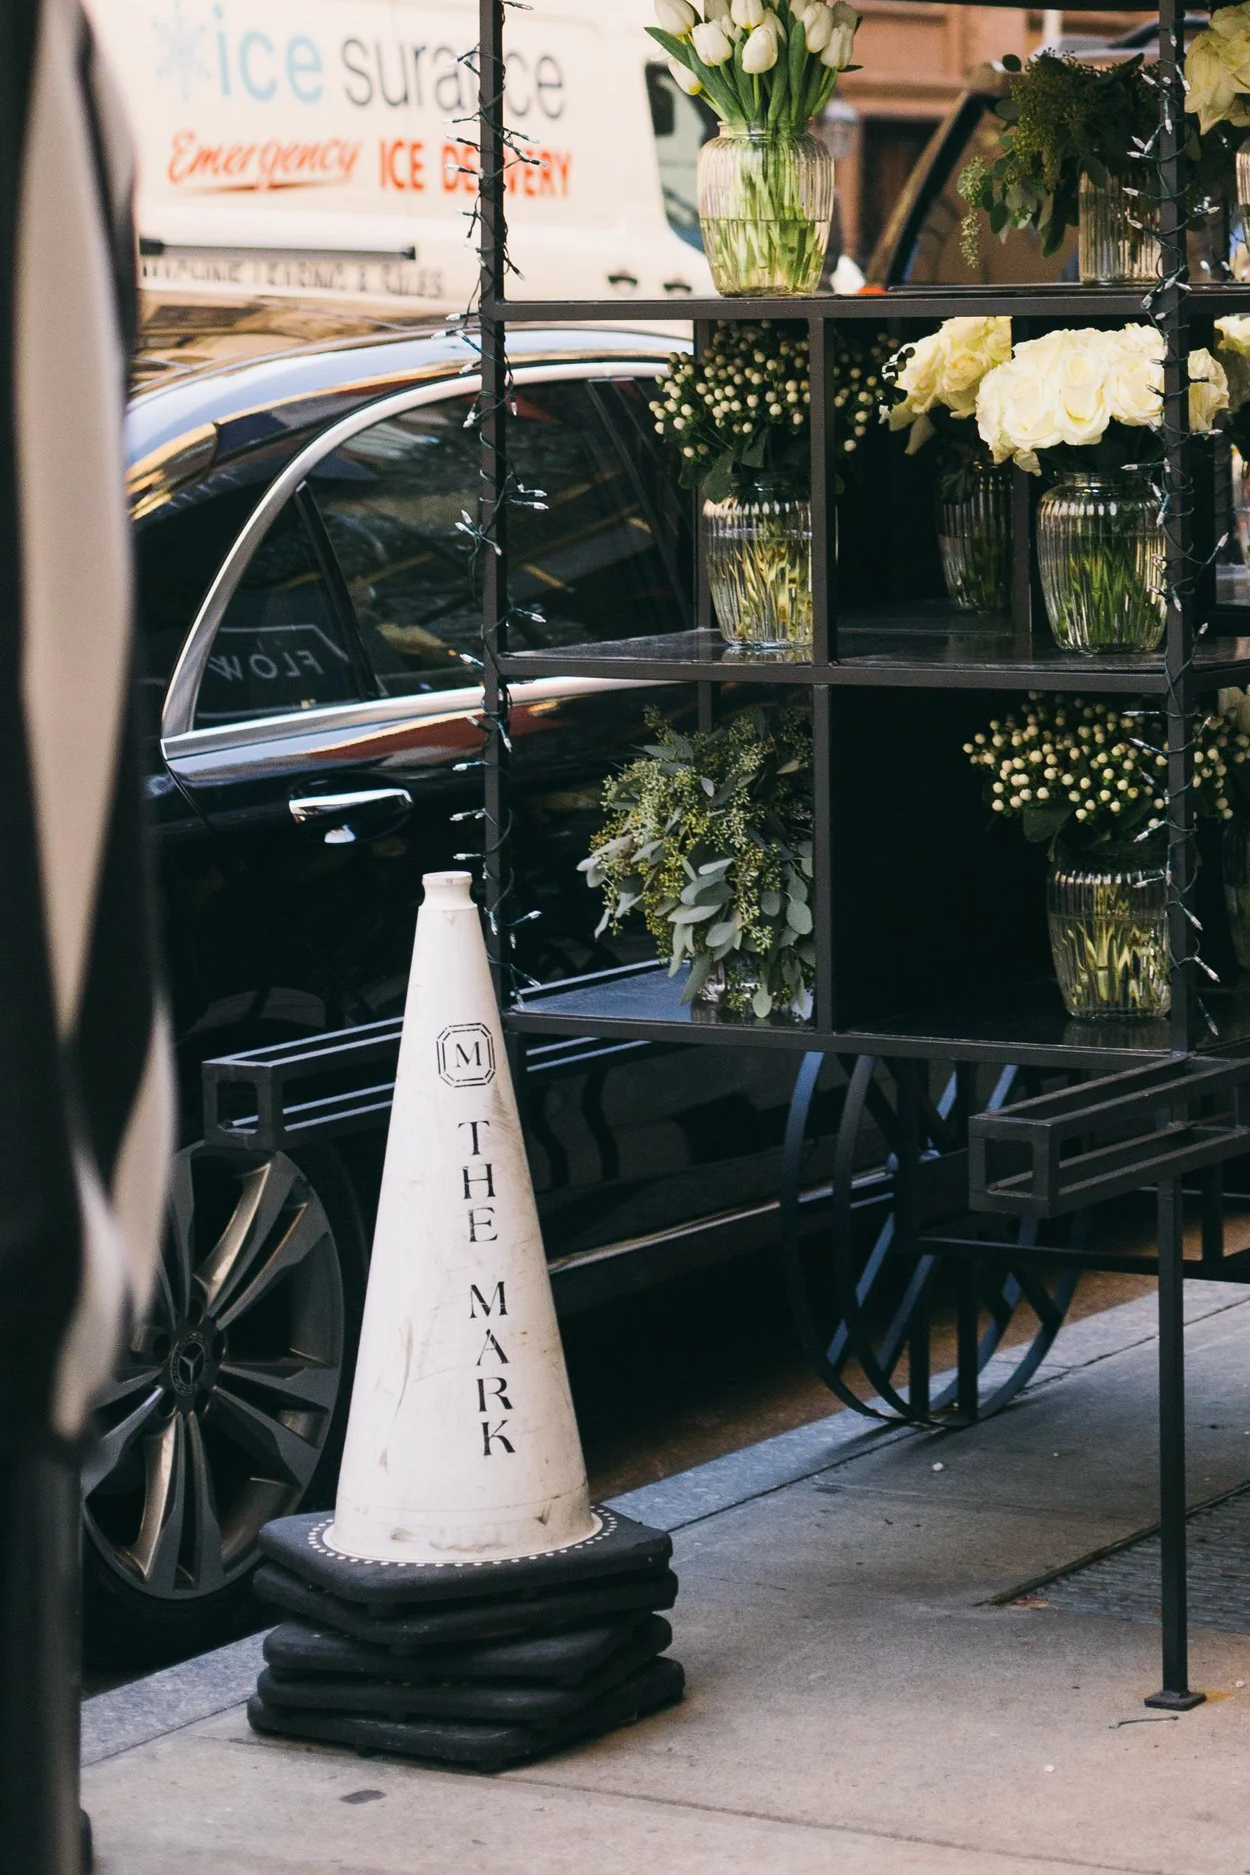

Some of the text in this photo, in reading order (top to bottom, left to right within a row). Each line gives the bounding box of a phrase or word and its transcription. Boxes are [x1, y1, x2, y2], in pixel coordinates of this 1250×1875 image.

[213, 2, 567, 120] ice surace
[167, 129, 573, 201] Emergency ICE DEVERY
[455, 1041, 482, 1068] M
[457, 1120, 517, 1457] THE MARK
